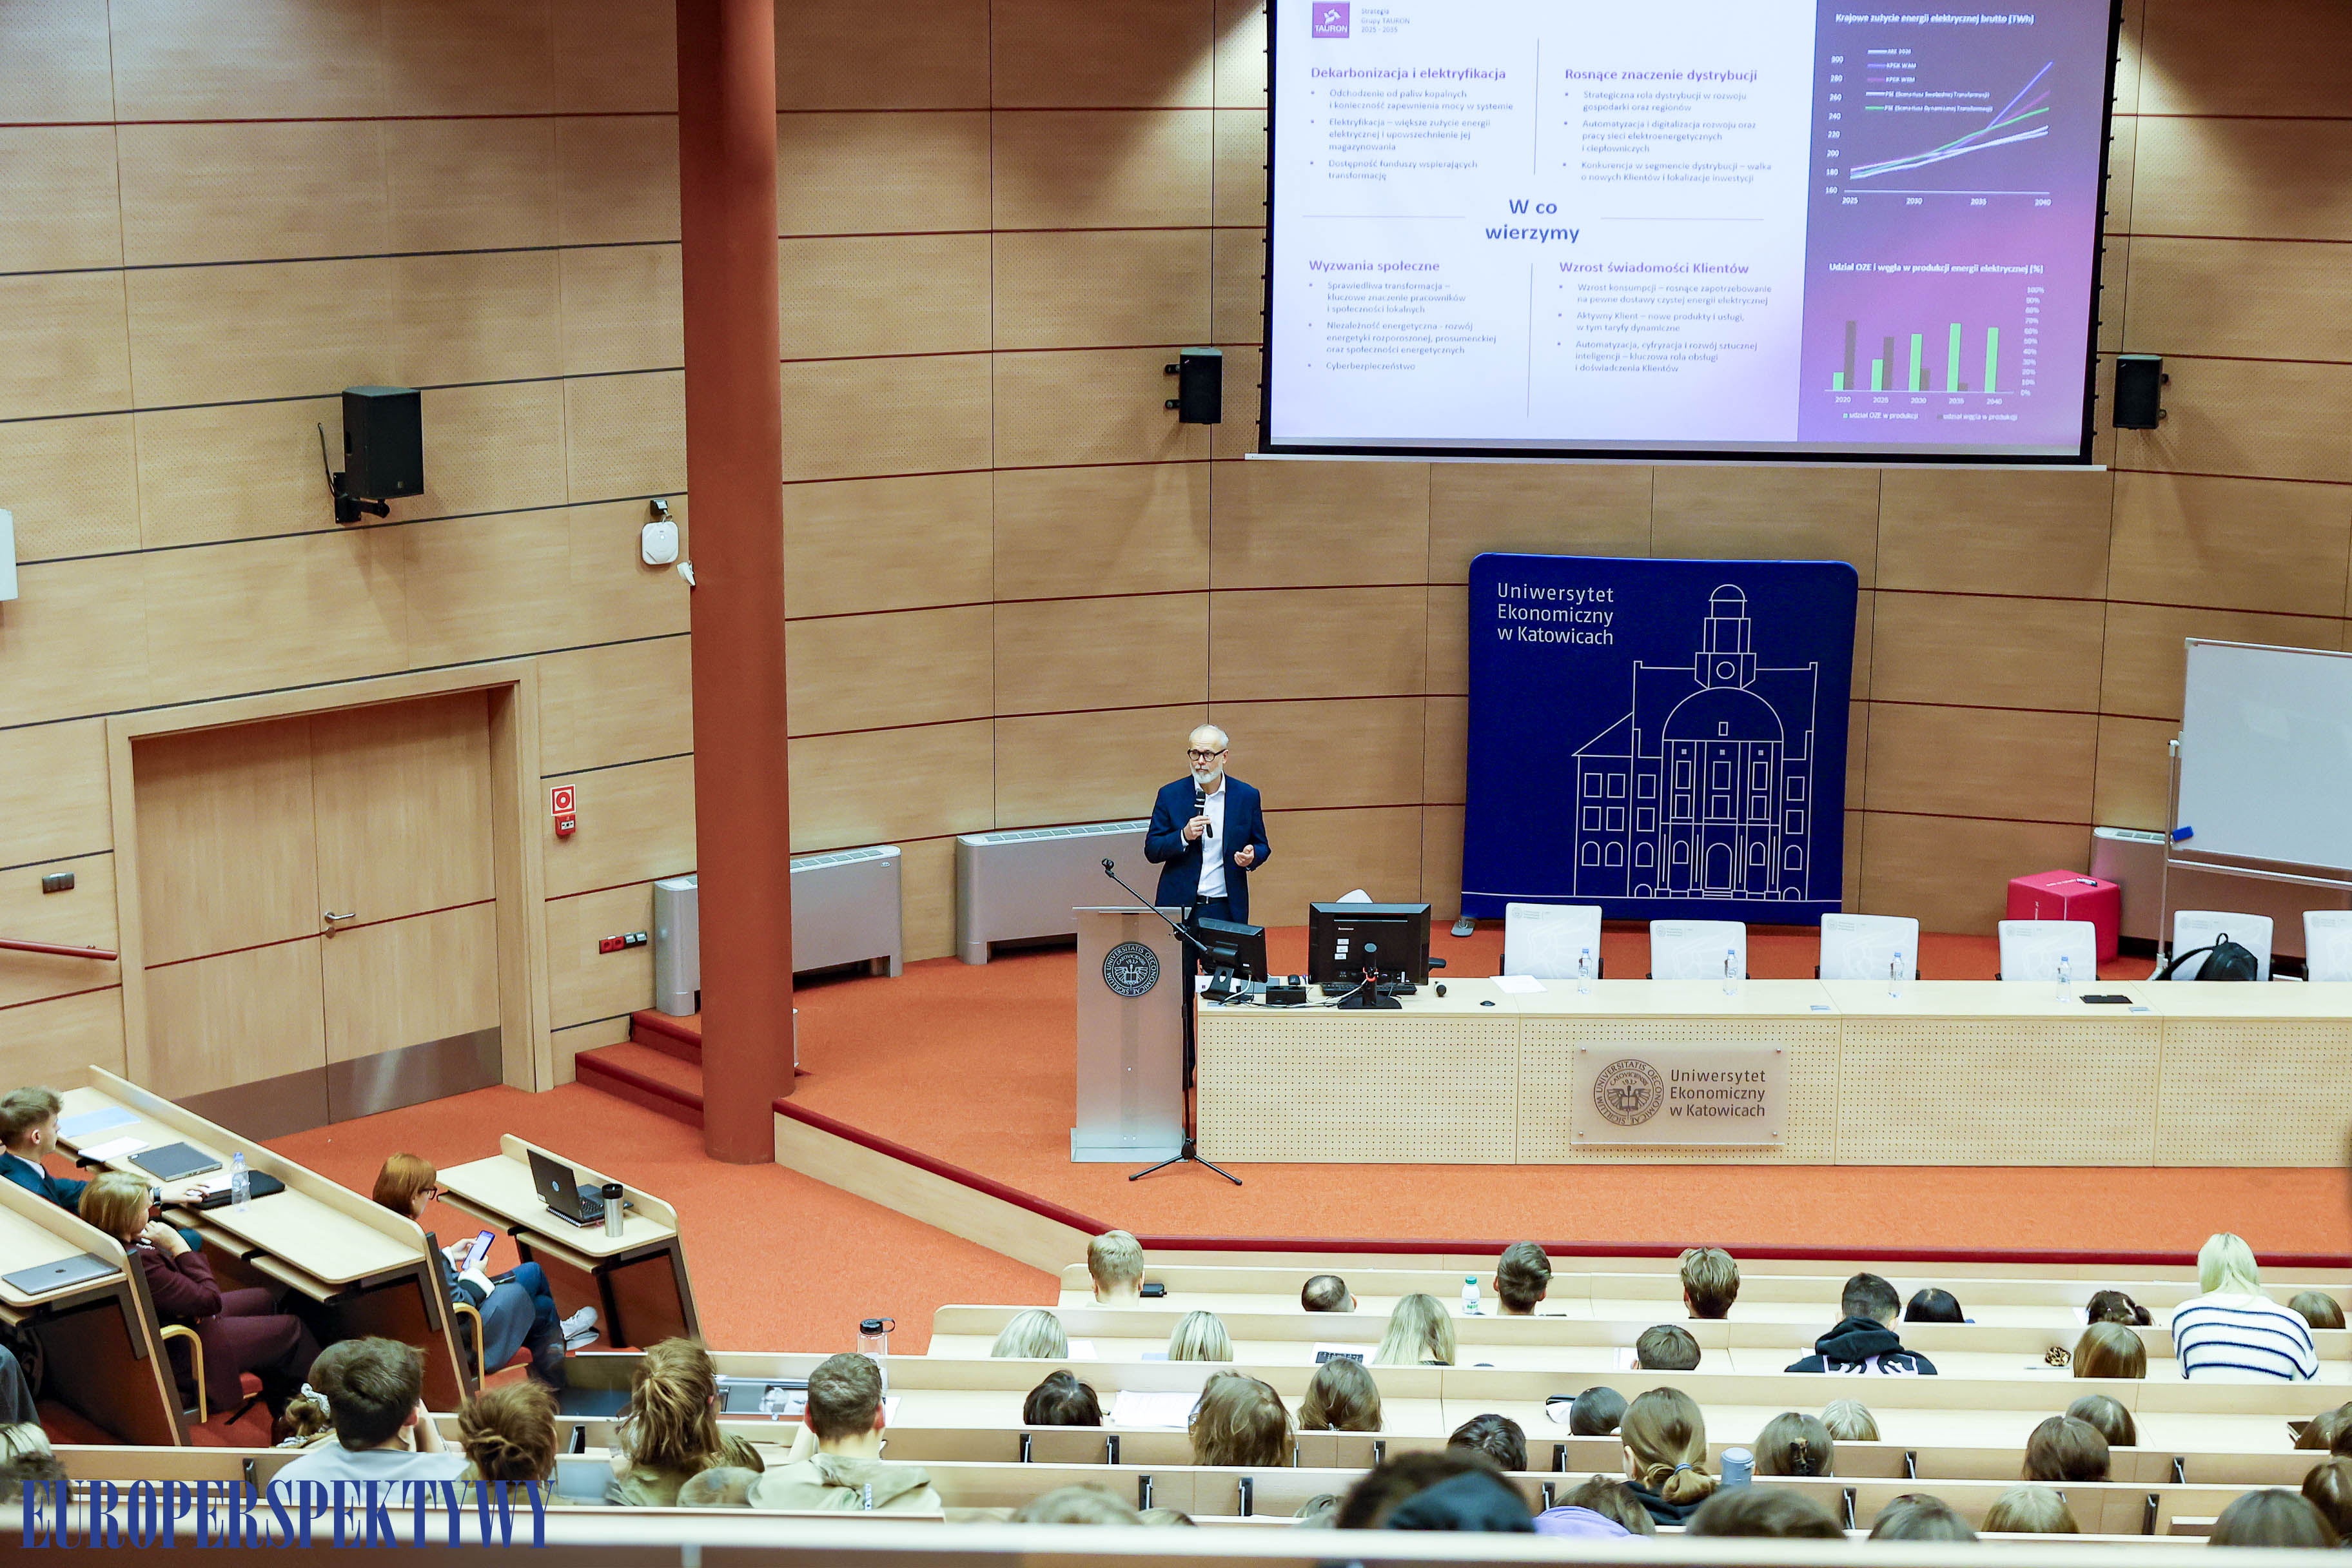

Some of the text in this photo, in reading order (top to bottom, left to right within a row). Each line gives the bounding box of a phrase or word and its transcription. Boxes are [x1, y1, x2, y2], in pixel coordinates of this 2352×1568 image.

[1315, 24, 1348, 33] TAURON
[1311, 66, 1505, 81] Dekarbonizacja elektryfikacja
[1565, 69, 1756, 83] Rosnące znaczenie dystrybucji
[1509, 199, 1557, 214] W co
[1485, 224, 1579, 243] wierzymy
[1309, 259, 1439, 273] Wyzwania społeczne
[1560, 262, 1749, 274] Wzrost świadomości Klientów
[1498, 583, 1614, 605] Uniwersytet
[1498, 603, 1613, 627] Ekonomiczny
[1498, 626, 1612, 645] w Katowicach
[1106, 946, 1144, 970] UNIVERSITATIS
[1596, 1061, 1646, 1093] UNIVERSITATIS
[1672, 1069, 1765, 1084] Uniwersytet
[1671, 1086, 1765, 1102] Ekonomiczny
[1670, 1104, 1765, 1117] w Katowicach
